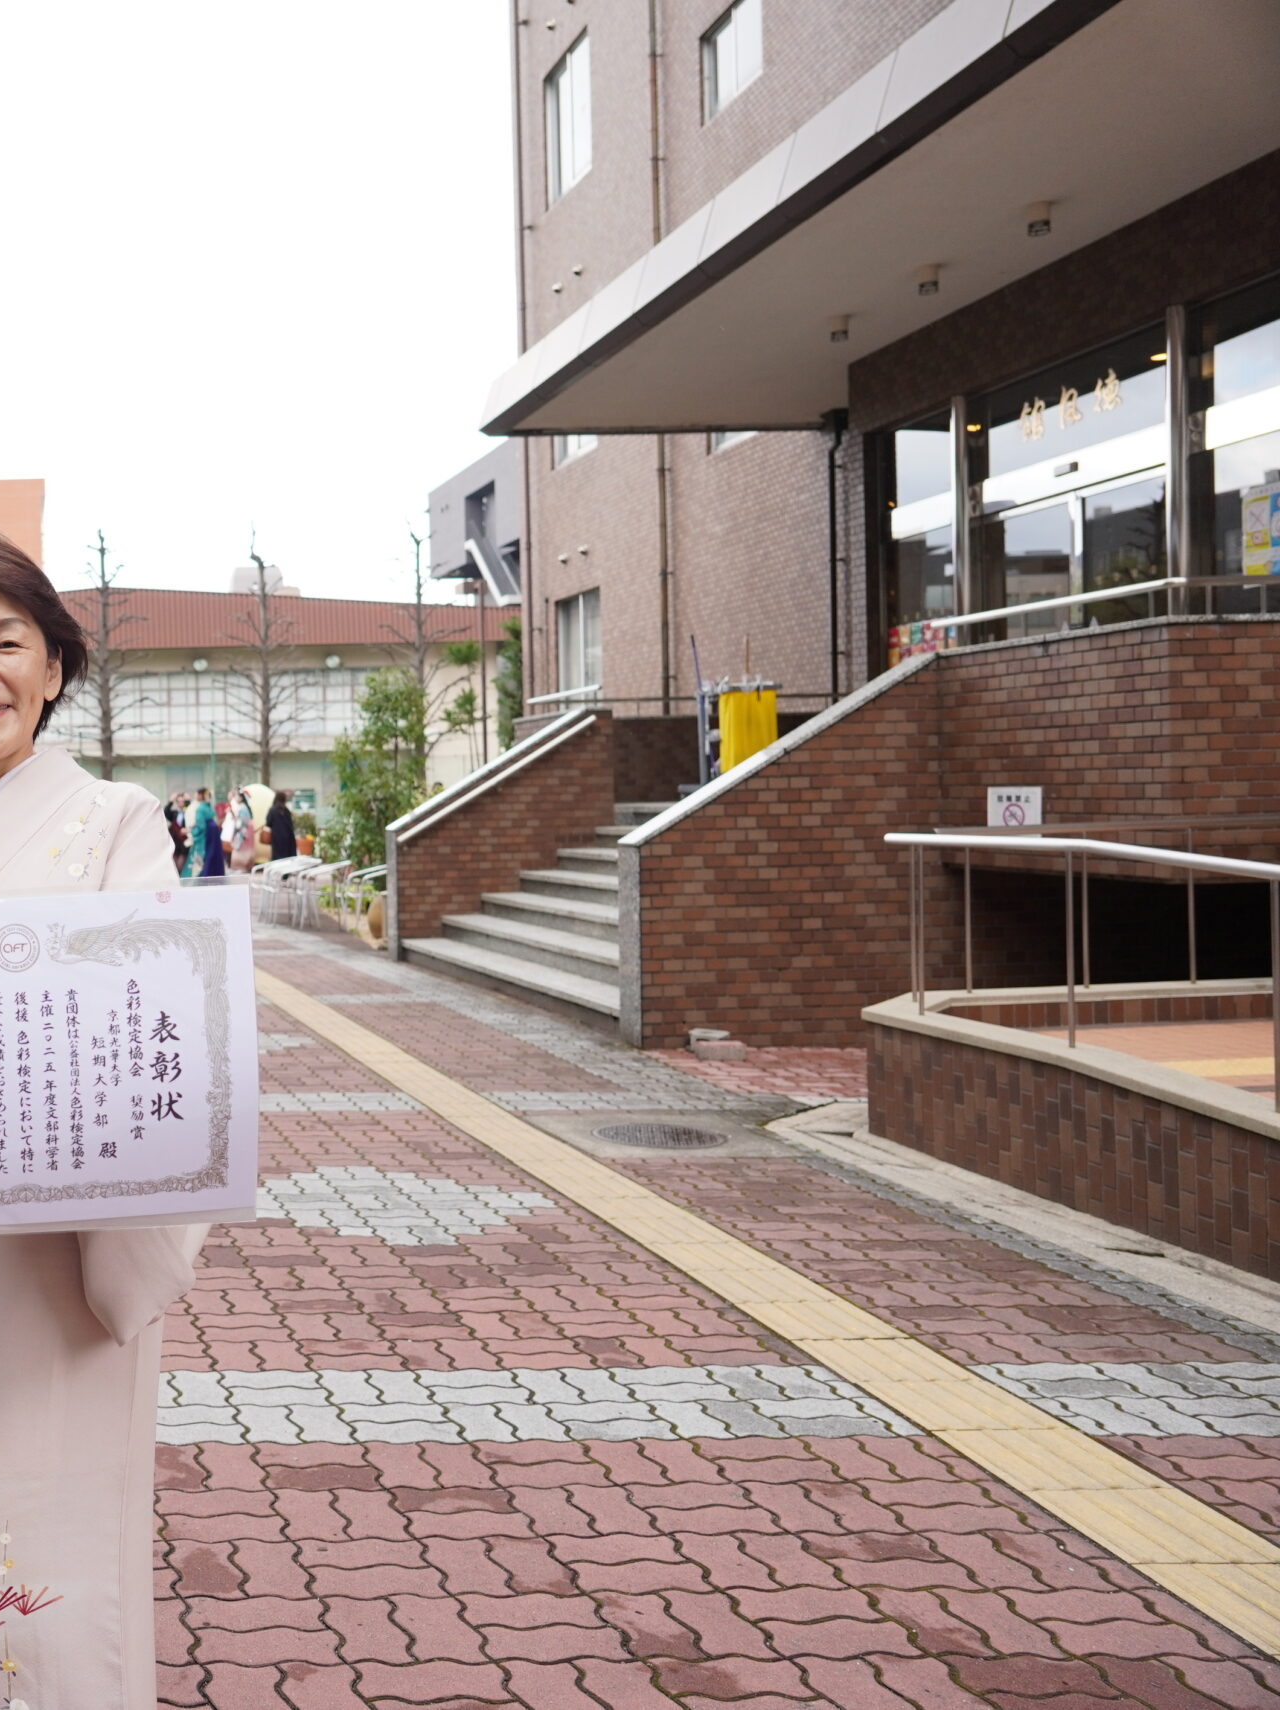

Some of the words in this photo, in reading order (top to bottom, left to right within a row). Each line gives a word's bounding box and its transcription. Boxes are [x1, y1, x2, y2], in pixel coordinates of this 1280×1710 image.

[107, 1009, 122, 1087] 京都光華大学
[126, 979, 144, 1077] 色彩検定協会
[149, 1010, 184, 1121] 表彰状
[90, 1036, 108, 1128] 短期大学部
[130, 1094, 145, 1140] 奨励賞
[98, 1141, 117, 1158] 殿
